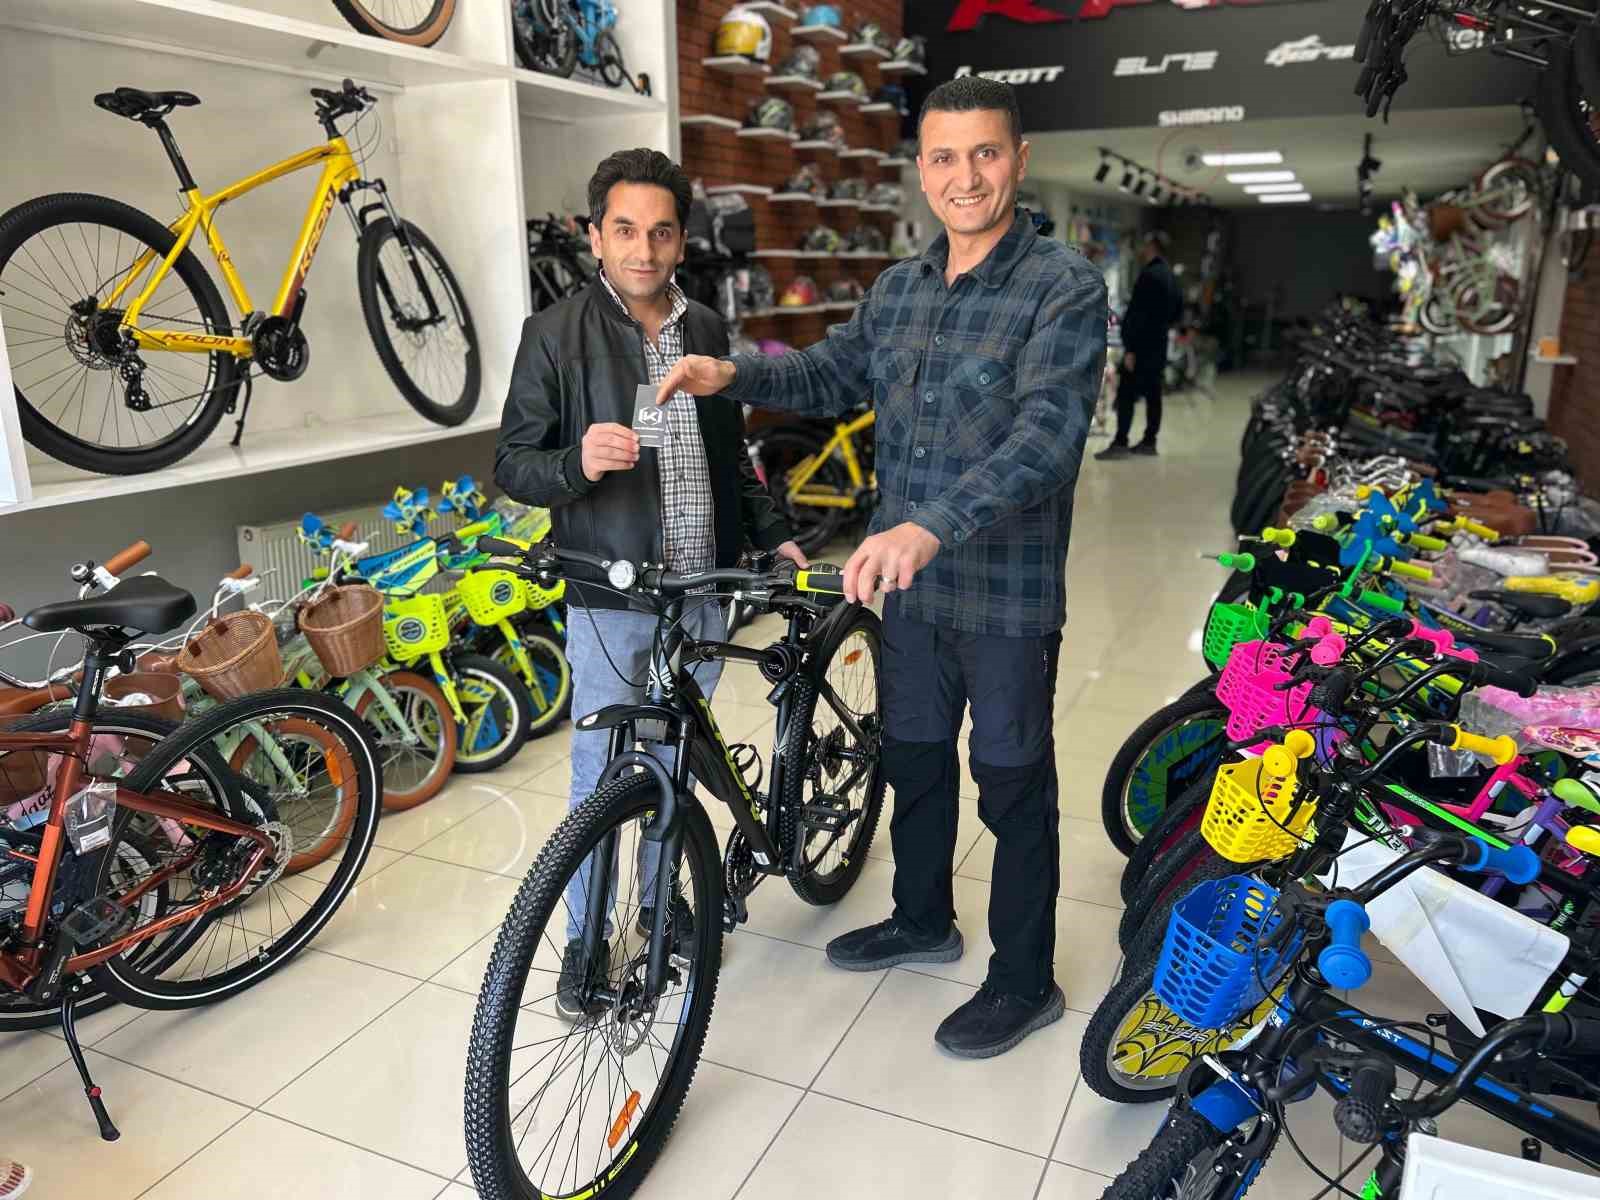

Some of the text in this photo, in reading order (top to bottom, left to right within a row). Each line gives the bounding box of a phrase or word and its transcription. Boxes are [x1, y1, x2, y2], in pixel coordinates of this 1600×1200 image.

[1157, 105, 1245, 127] SHIMANO
[300, 189, 335, 279] KRON
[162, 332, 237, 346] KRON
